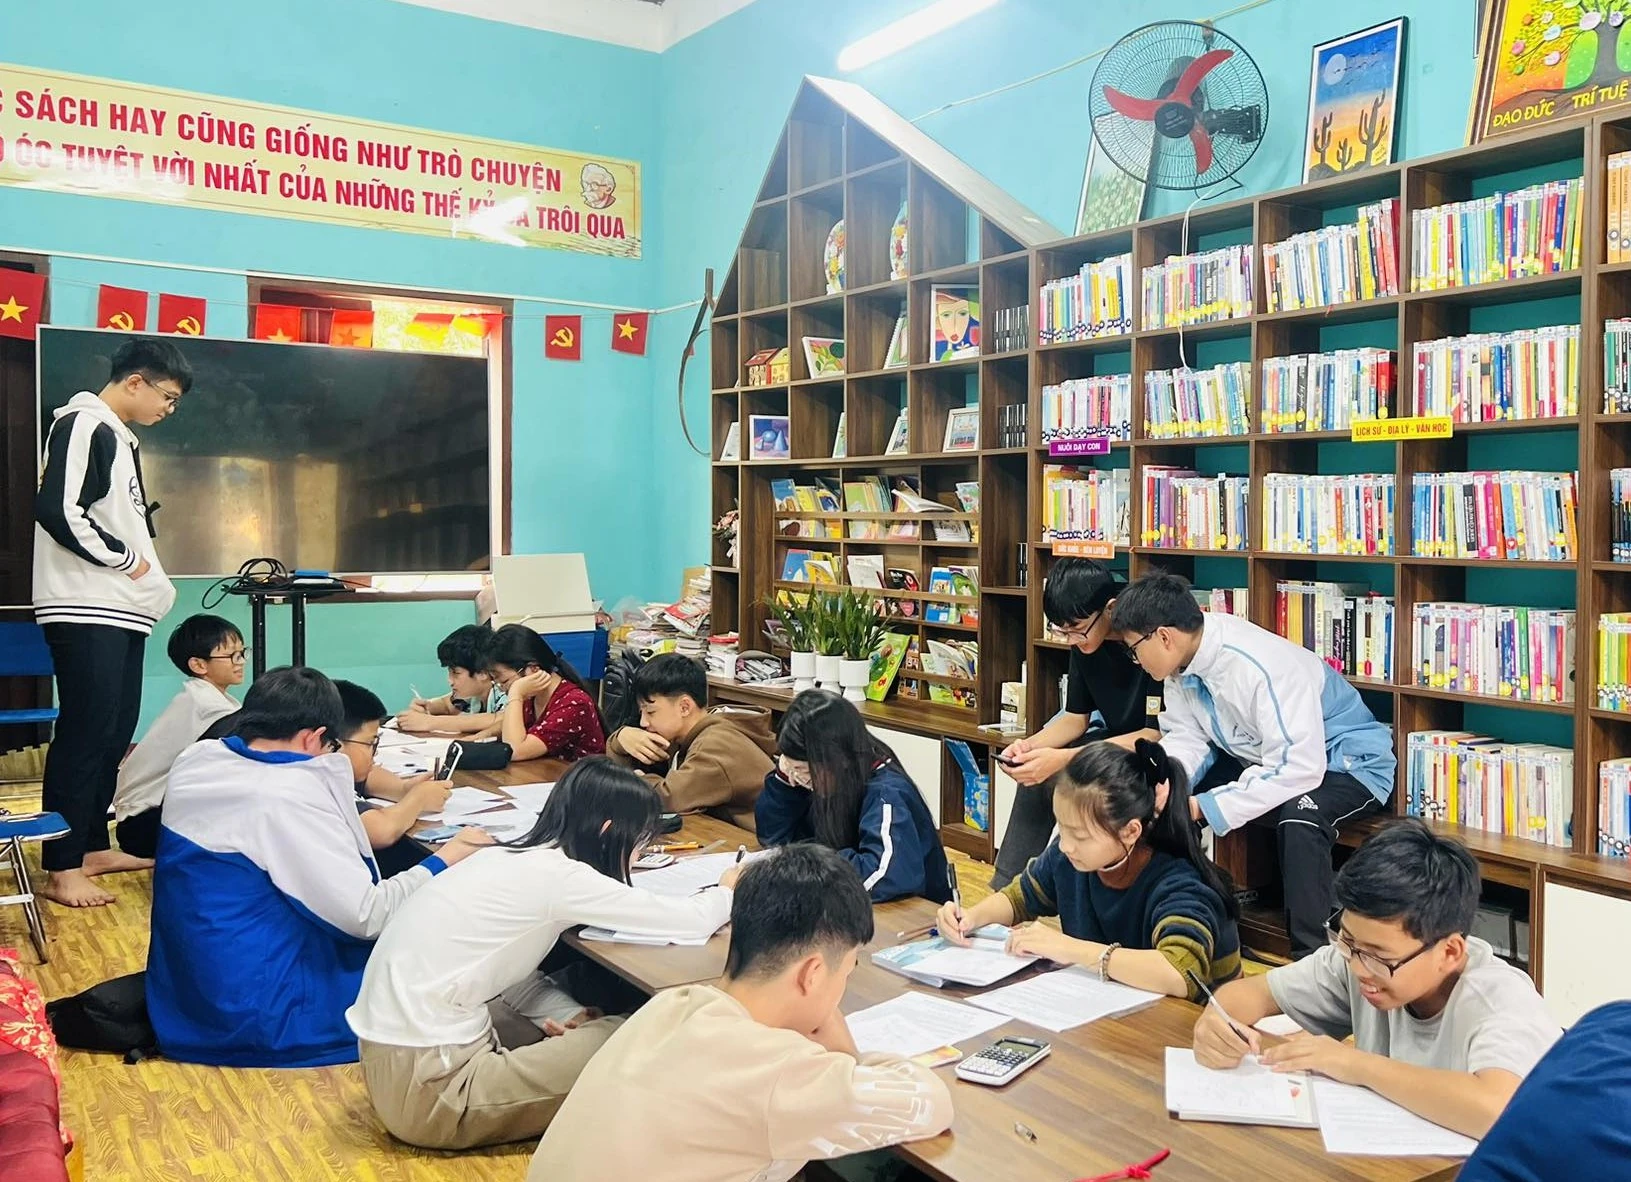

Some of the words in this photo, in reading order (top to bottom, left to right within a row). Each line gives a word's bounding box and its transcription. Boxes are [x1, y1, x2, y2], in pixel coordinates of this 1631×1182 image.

[1493, 109, 1522, 127] ĐẠO
[1524, 98, 1555, 120] ĐỨC
[1572, 85, 1599, 109] TRÍ
[1599, 80, 1629, 102] TUỆ
[16, 88, 98, 127] SÁCH
[110, 103, 166, 136] HAY
[178, 111, 255, 149] CŨNG
[266, 123, 348, 162] GIỐNG
[357, 140, 412, 171] NHƯ
[417, 148, 462, 178] TRÒ
[471, 157, 561, 194] CHUYỆN
[153, 151, 195, 186] VỜI
[204, 159, 270, 195] NHẤT
[279, 163, 327, 204] CỦA
[336, 178, 415, 213] NHỮNG
[422, 187, 462, 219] THẾ
[536, 205, 579, 234] TRÔI
[587, 213, 625, 240] QUA
[1087, 442, 1101, 450] CON
